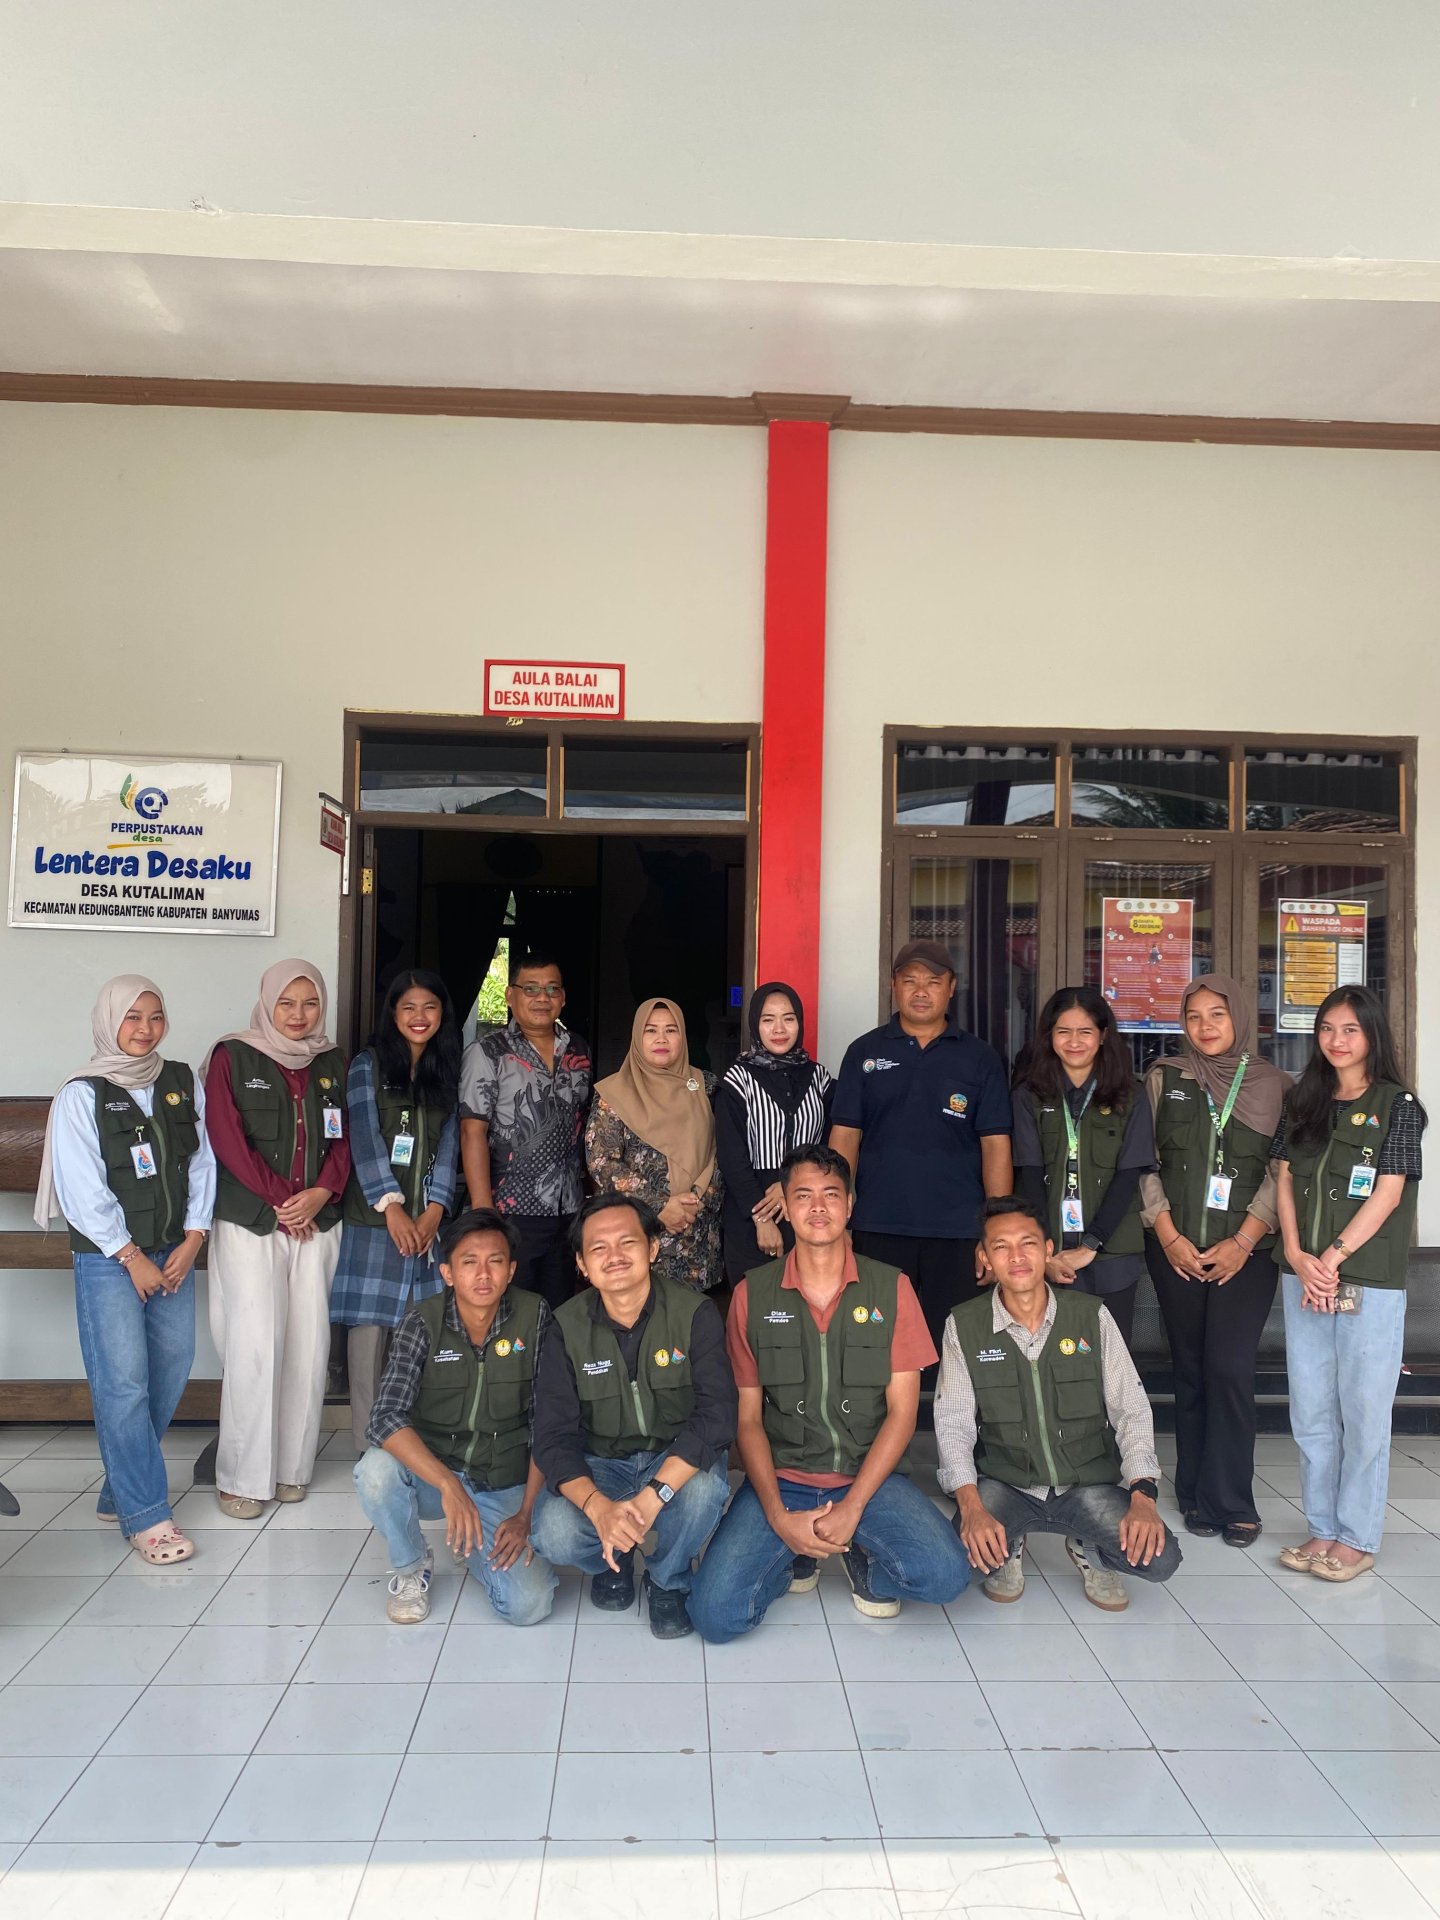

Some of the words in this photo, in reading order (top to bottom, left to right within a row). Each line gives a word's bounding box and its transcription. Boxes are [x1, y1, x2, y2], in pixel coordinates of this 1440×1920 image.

[512, 671, 550, 686] AULA
[555, 672, 598, 687] BALAI
[494, 690, 530, 705] DESA
[534, 691, 615, 708] KUTALIMAN
[111, 822, 203, 836] PERPUSTAKAAN
[132, 831, 163, 843] desa
[34, 846, 139, 878] Lentera
[146, 850, 252, 881] Desaku
[81, 883, 118, 898] DESA
[122, 884, 205, 901] KUTALIMAN
[24, 901, 77, 915] KECAMATAN
[78, 903, 155, 918] KEDUNGBANTENG
[157, 905, 208, 920] KABUPATEN
[212, 907, 260, 922] BANYUMAS
[1132, 919, 1139, 928] 8
[1301, 917, 1341, 926] WASPADA
[1342, 926, 1364, 934] ONLINE
